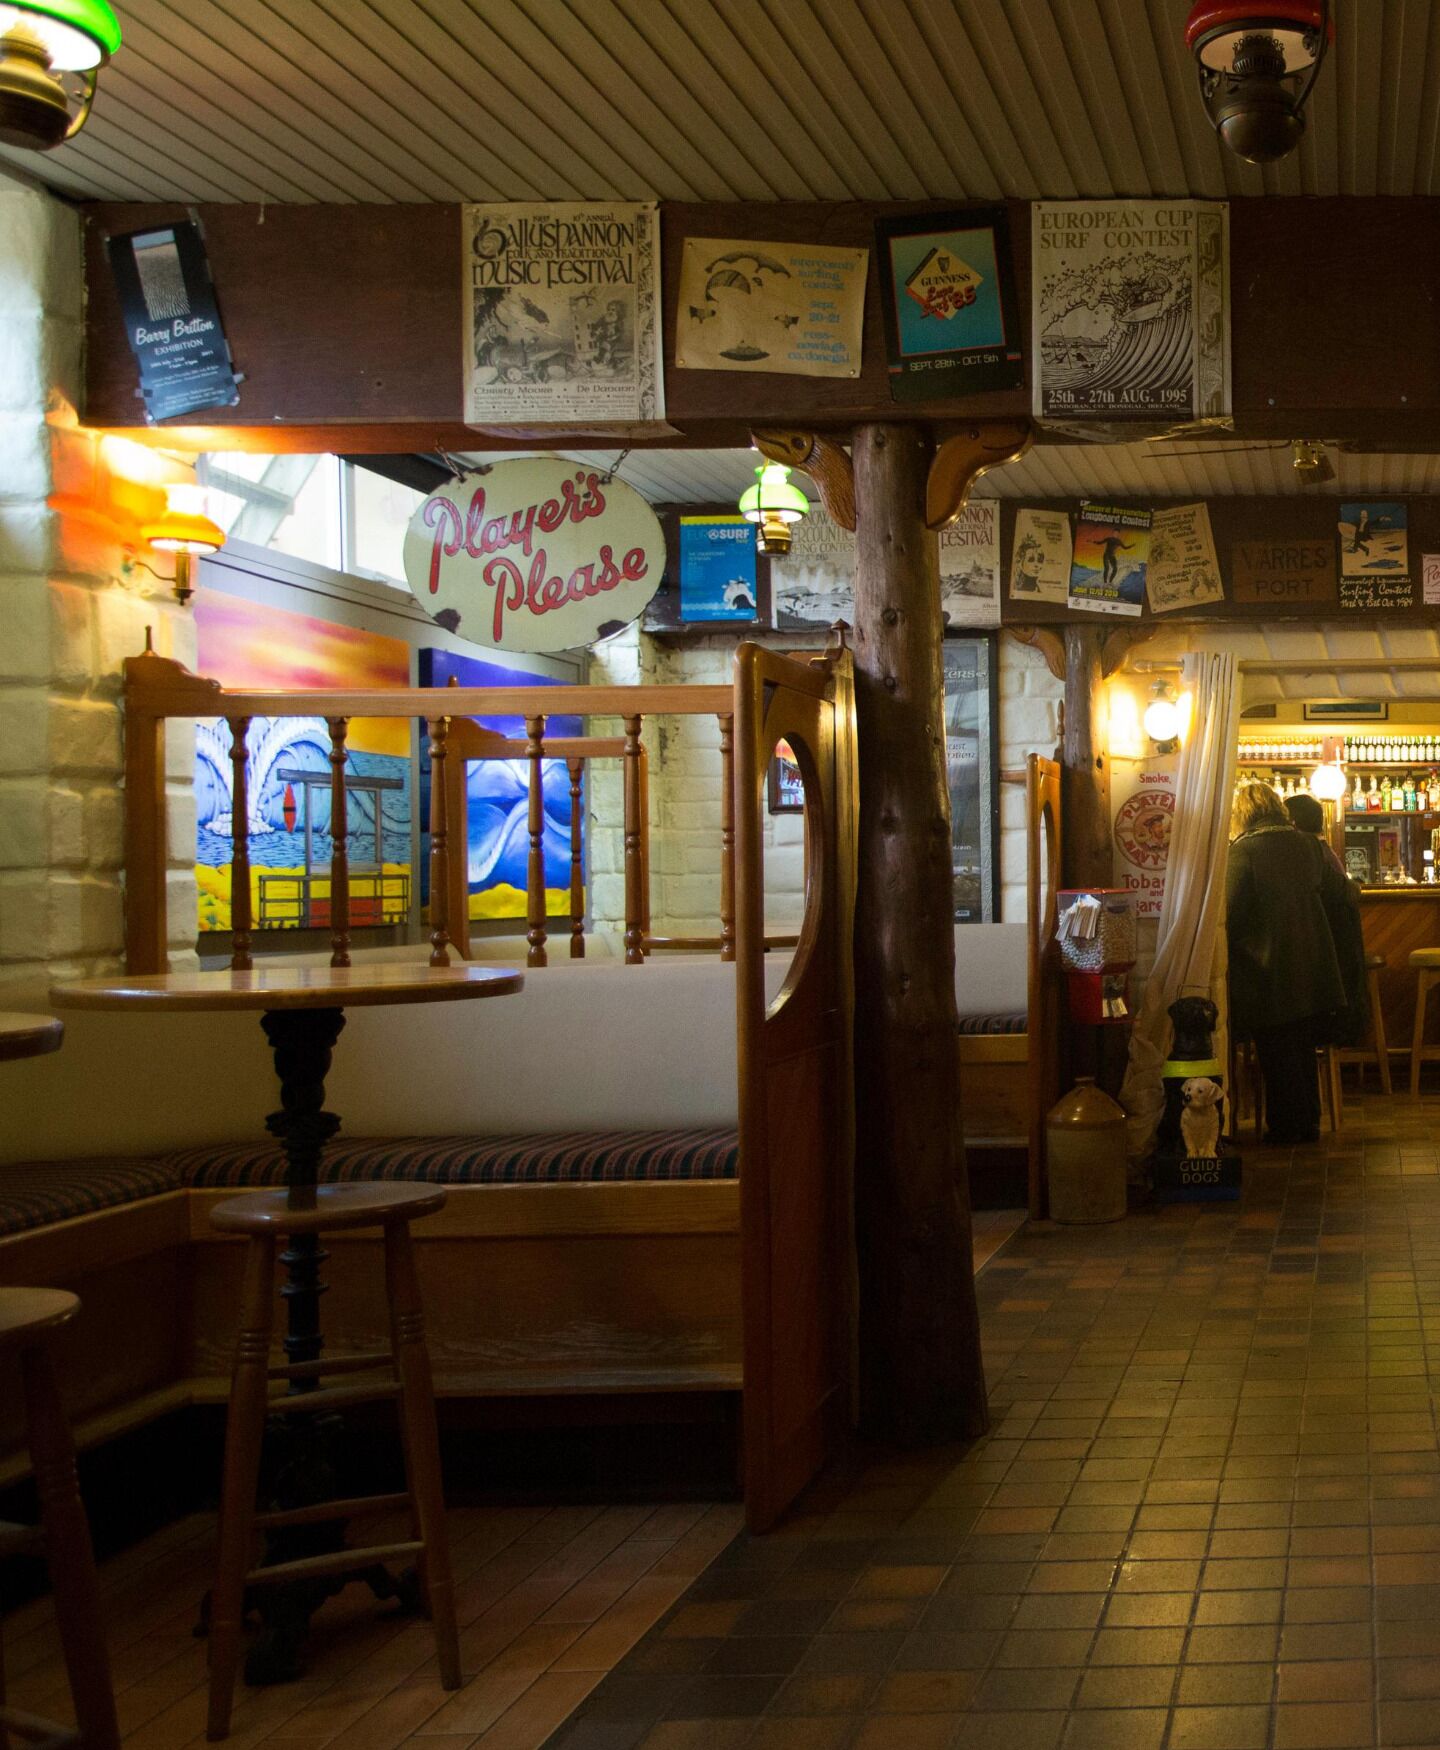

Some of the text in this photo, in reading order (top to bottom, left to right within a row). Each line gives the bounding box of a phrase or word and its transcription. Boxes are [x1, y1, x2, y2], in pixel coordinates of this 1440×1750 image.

[1040, 210, 1193, 230] EUROPEAN CUP
[1040, 230, 1193, 249] SURF CONTEST
[920, 273, 971, 287] GUINNESS
[135, 318, 215, 346] Barry Britton
[154, 339, 204, 356] EXHIBITION
[934, 358, 956, 370] 28th
[983, 353, 1000, 364] 5th
[1048, 389, 1075, 403] 25th
[1089, 389, 1115, 403] 27th
[1120, 389, 1154, 403] AUG.
[1160, 389, 1187, 403] 1995
[1081, 511, 1151, 528] Longboard Contest
[422, 471, 606, 594] Player's
[941, 528, 995, 550] FESTIVAL
[482, 544, 649, 642] Please
[1255, 578, 1315, 596] PORT
[1340, 585, 1374, 599] Surfing
[1378, 584, 1412, 595] Contest
[1149, 889, 1164, 897] and
[1179, 1159, 1223, 1172] GUIDE
[1181, 1171, 1220, 1184] DOGS
